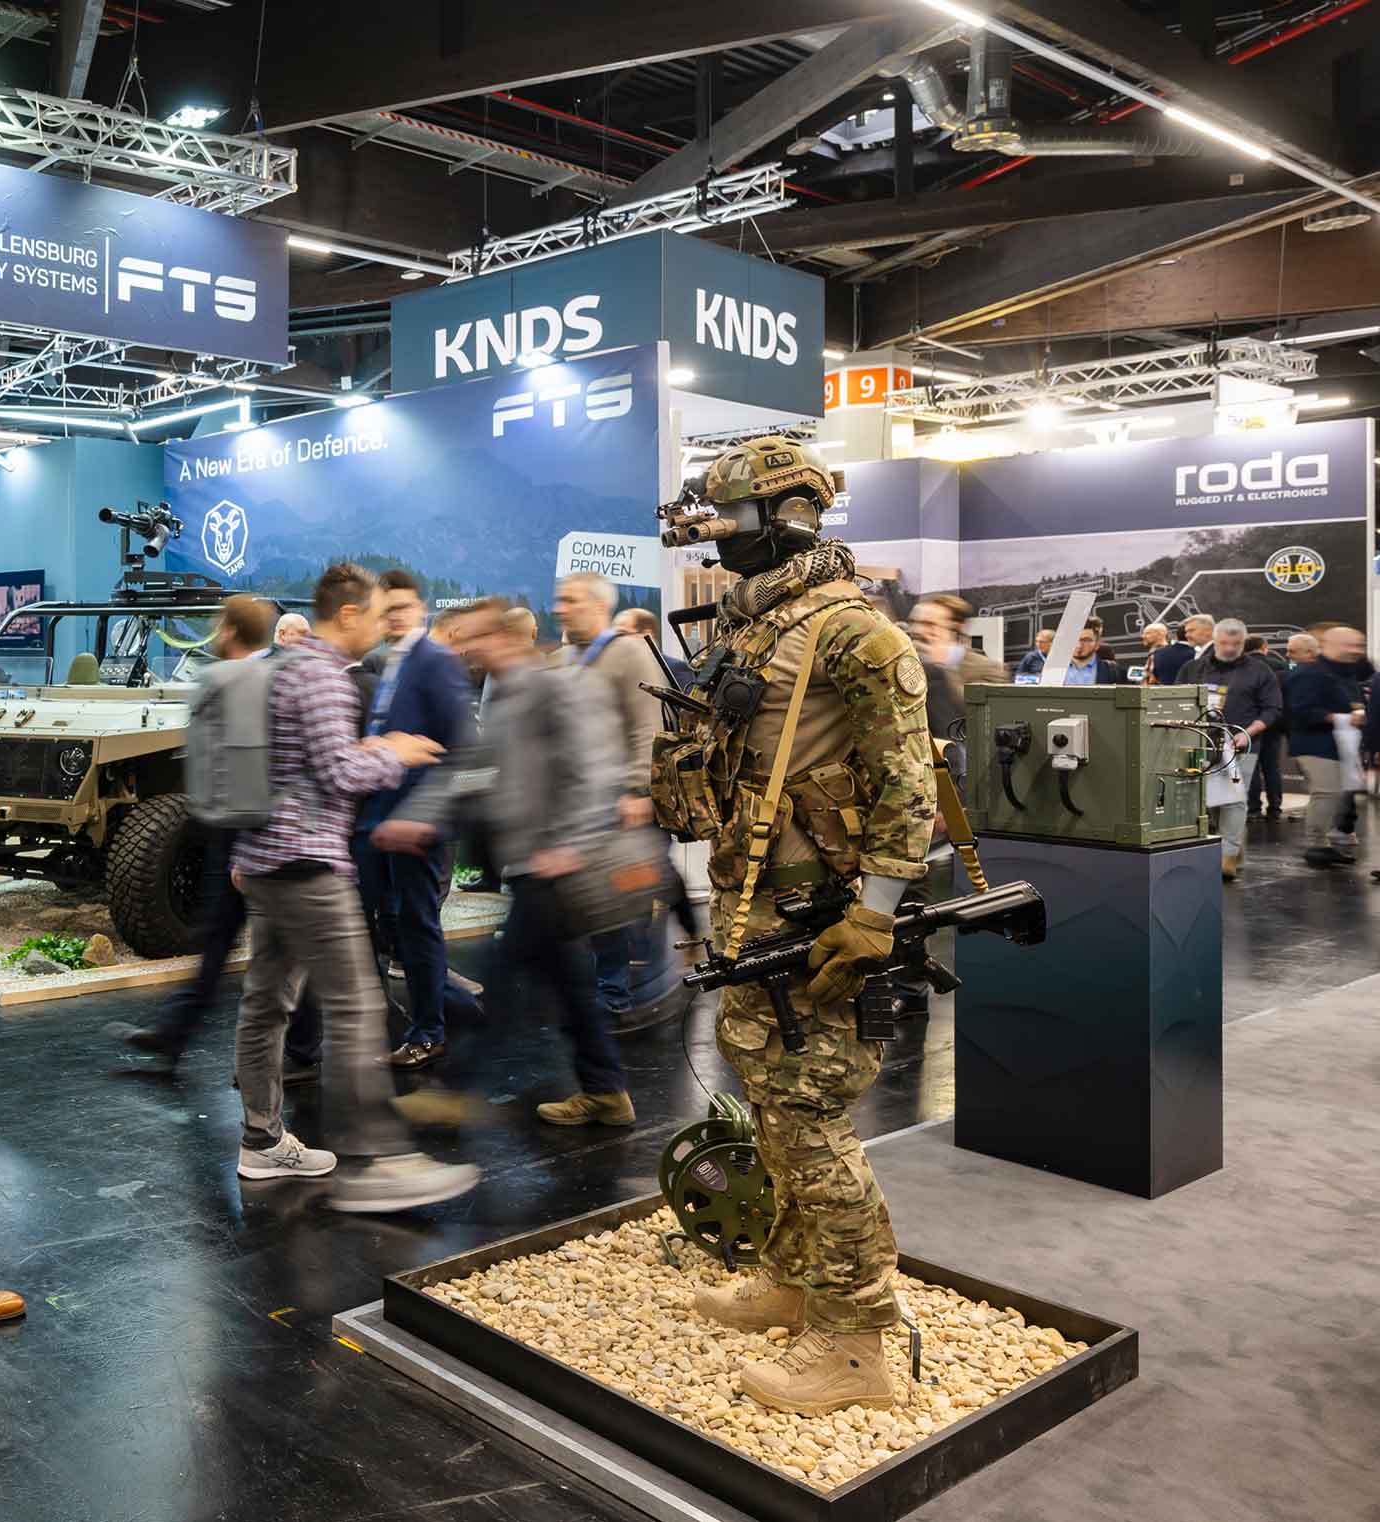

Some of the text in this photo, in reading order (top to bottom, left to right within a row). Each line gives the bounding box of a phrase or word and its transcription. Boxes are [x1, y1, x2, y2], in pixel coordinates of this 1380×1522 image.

[13, 265, 98, 296] SYSTEMS
[118, 256, 257, 322] FTS
[435, 294, 604, 379] KNDS
[695, 288, 799, 366] KNDS
[492, 373, 633, 437] FTS
[860, 375, 876, 399] 9
[178, 433, 388, 482] A New Era of Defence.
[1176, 451, 1329, 496] roda
[1176, 495, 1221, 506] RUGGED
[1223, 494, 1233, 503] IT
[1247, 487, 1329, 501] ELECTRONICS
[226, 558, 245, 577] TAHR
[570, 559, 635, 579] PROVEN.
[571, 541, 636, 560] COMBAT
